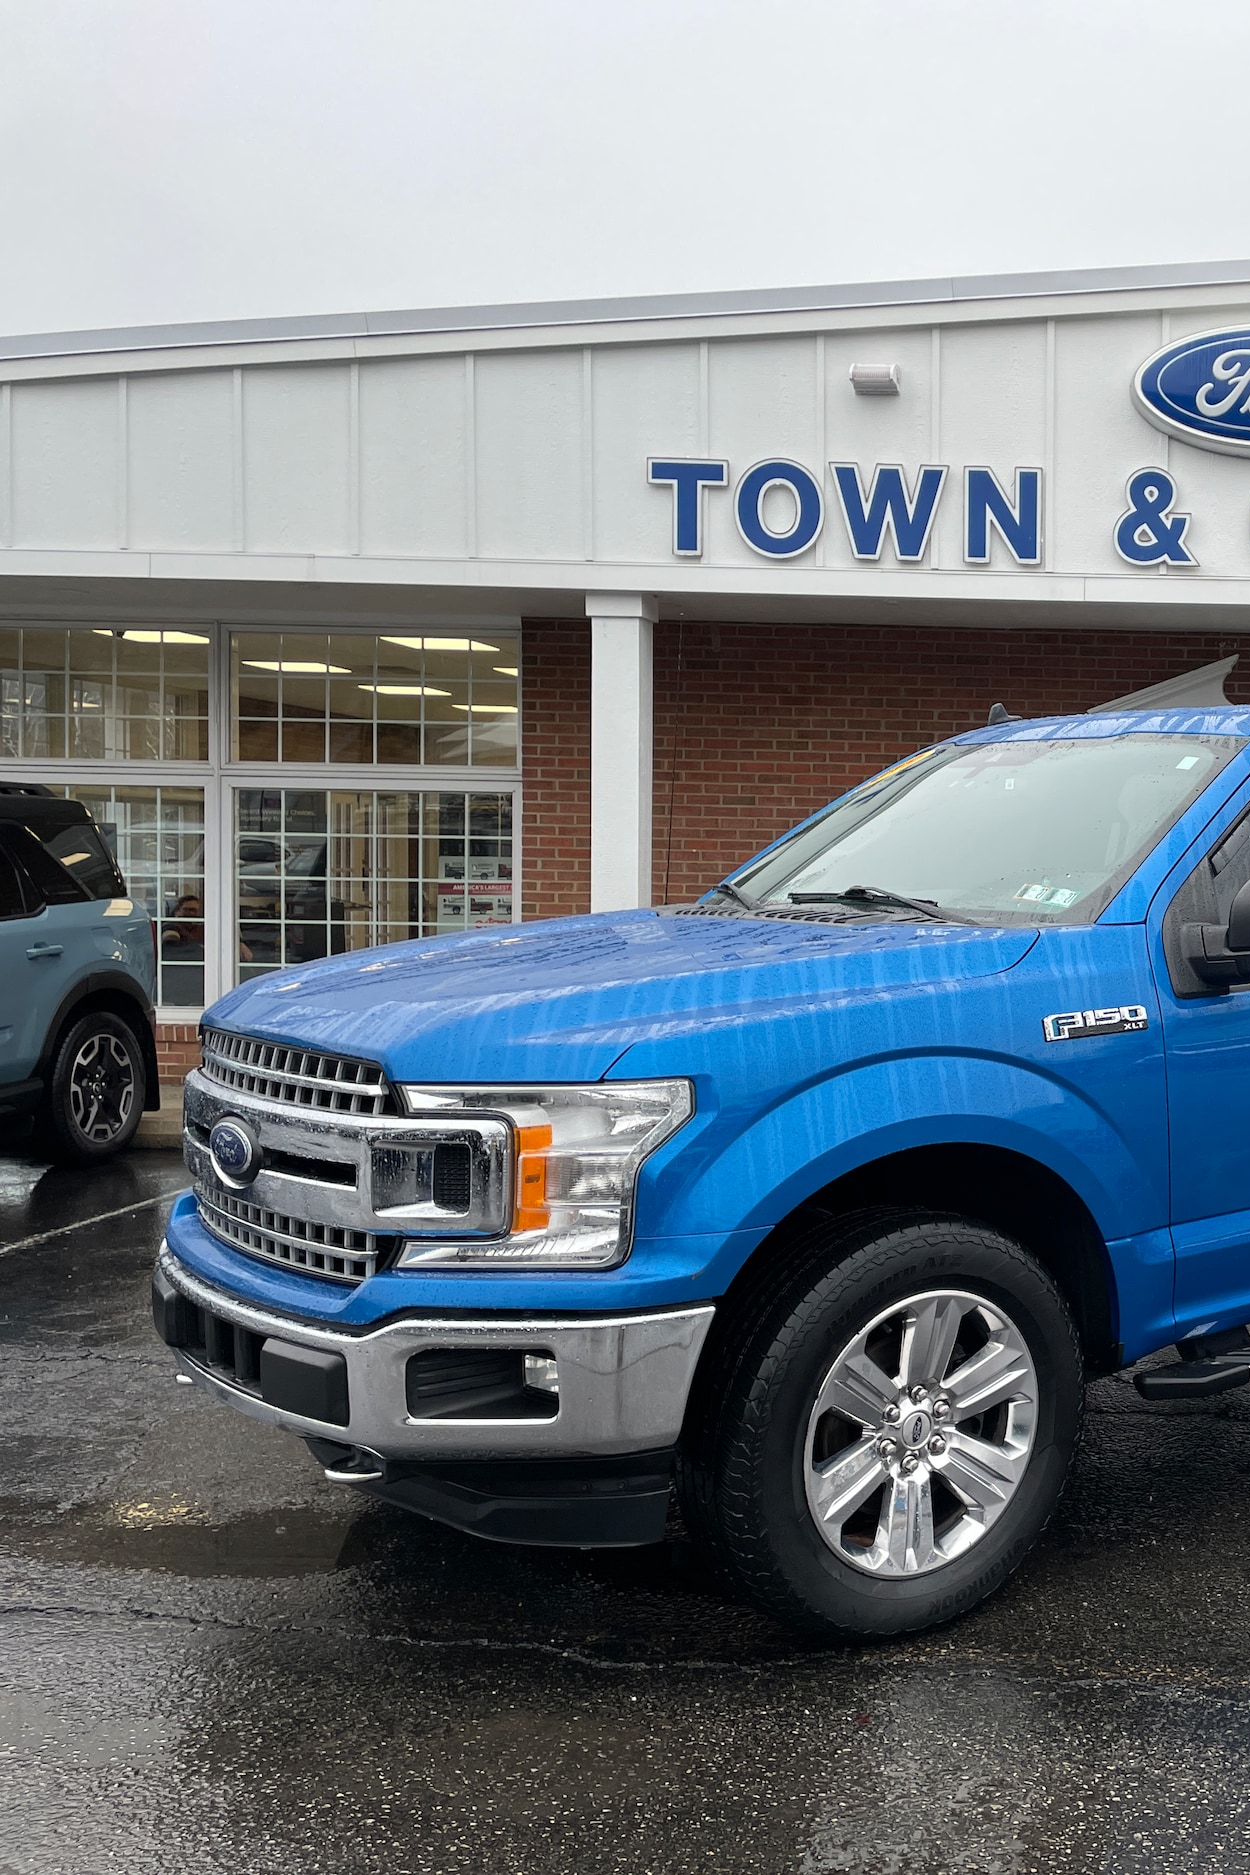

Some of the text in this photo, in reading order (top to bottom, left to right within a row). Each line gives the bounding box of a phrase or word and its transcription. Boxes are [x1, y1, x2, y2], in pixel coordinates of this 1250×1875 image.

[646, 456, 1043, 566] TOWN
[1113, 466, 1201, 567] &
[1123, 1020, 1145, 1031] XLT
